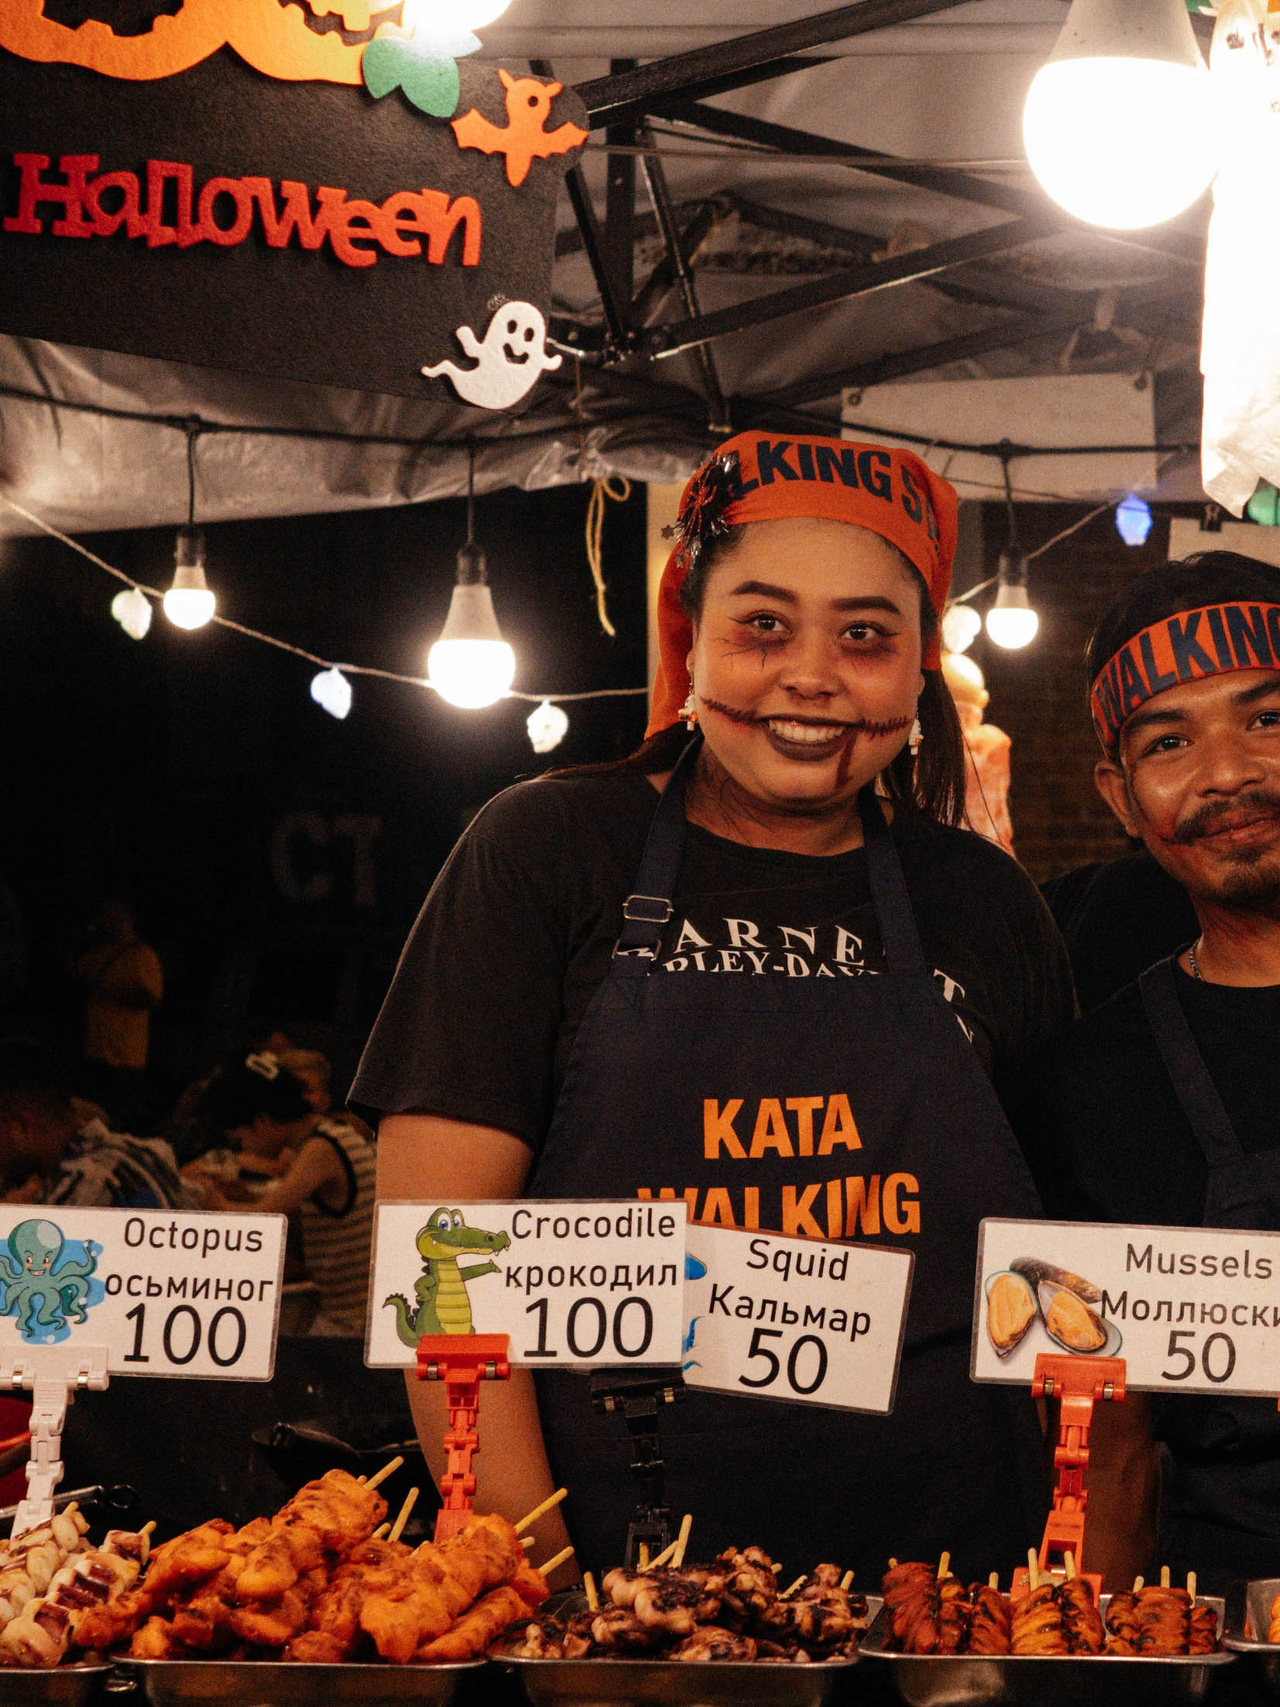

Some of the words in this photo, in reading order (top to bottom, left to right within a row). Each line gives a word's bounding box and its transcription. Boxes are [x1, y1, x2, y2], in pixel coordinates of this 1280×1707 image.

[3, 152, 483, 268] Halloween
[703, 1093, 863, 1159] KATA
[124, 1217, 263, 1259] Octopus
[511, 1207, 676, 1240] Crocodile
[105, 1273, 274, 1302] осьминог
[505, 1264, 678, 1296] крокодил
[746, 1238, 850, 1282] Squid
[1125, 1242, 1273, 1280] Mussels
[123, 1302, 247, 1367] 100
[523, 1296, 654, 1358] 100
[708, 1283, 871, 1342] Кальмар
[738, 1327, 829, 1395] 50
[1160, 1329, 1237, 1384] 50
